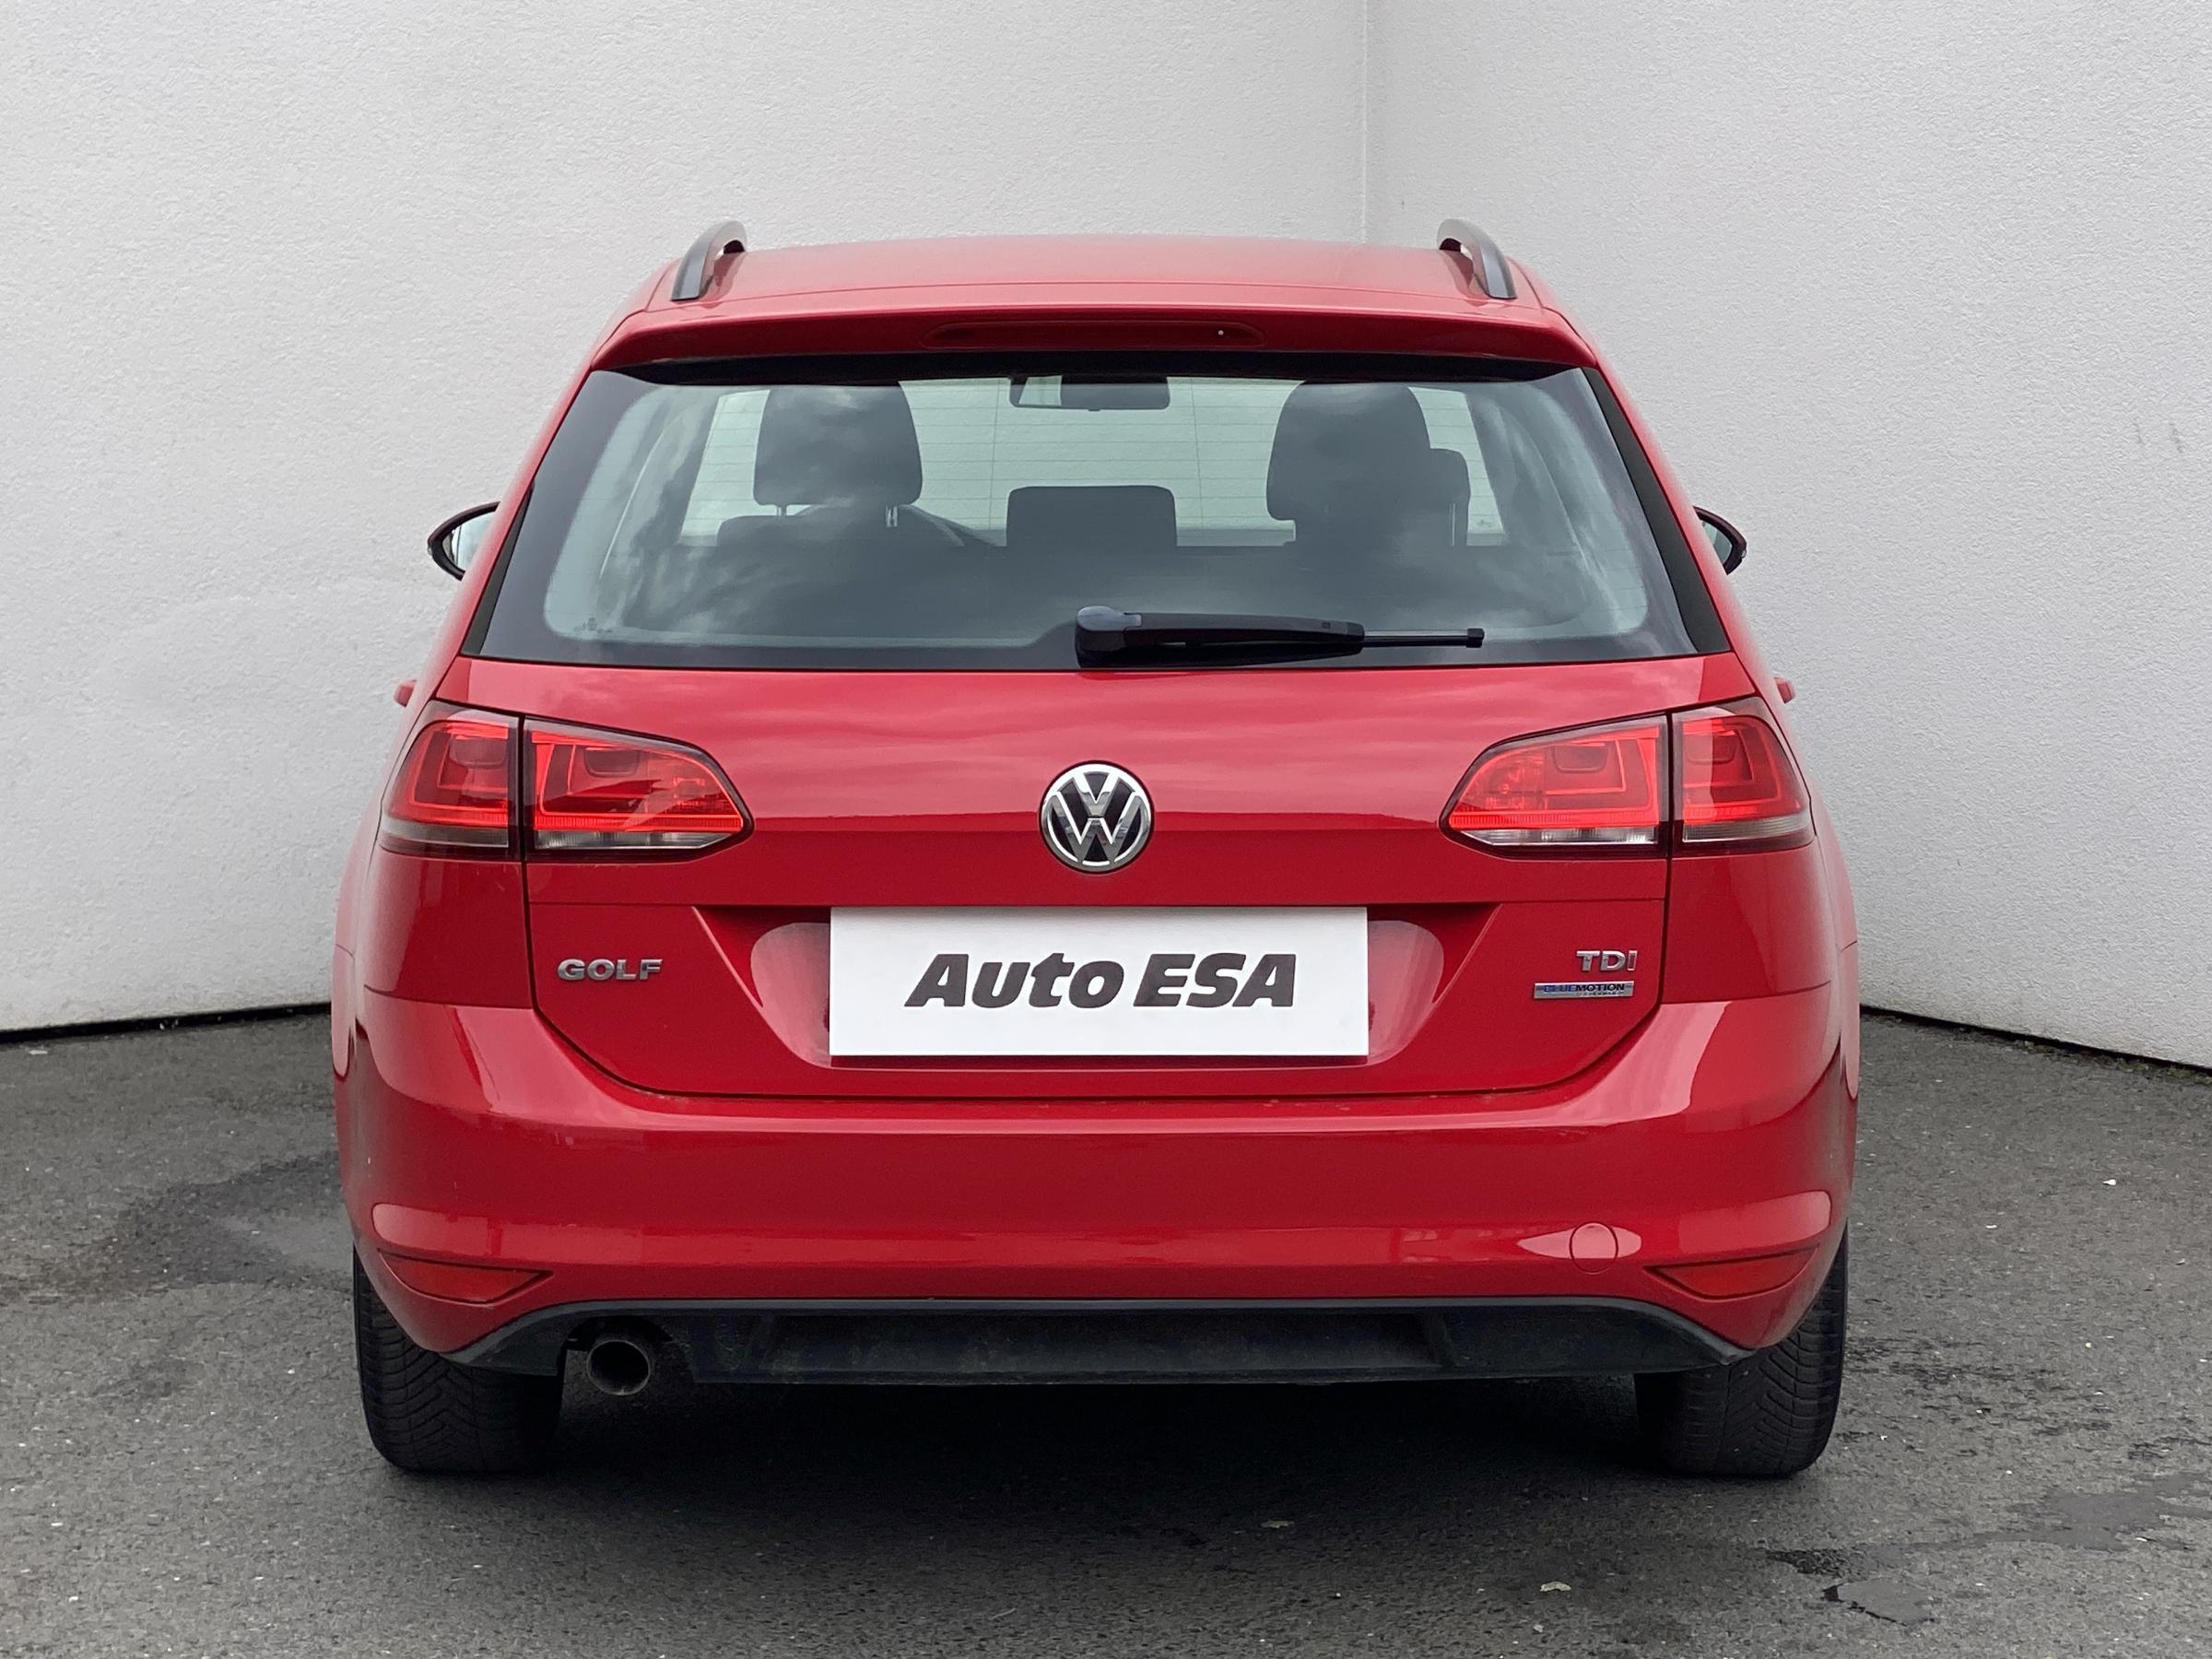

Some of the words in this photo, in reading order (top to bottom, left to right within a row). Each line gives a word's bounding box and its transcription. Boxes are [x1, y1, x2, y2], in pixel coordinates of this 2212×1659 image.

[557, 958, 663, 981] GOLF
[1575, 949, 1638, 971] TDI
[903, 952, 1124, 1009] Auto
[1133, 953, 1297, 1008] ESA
